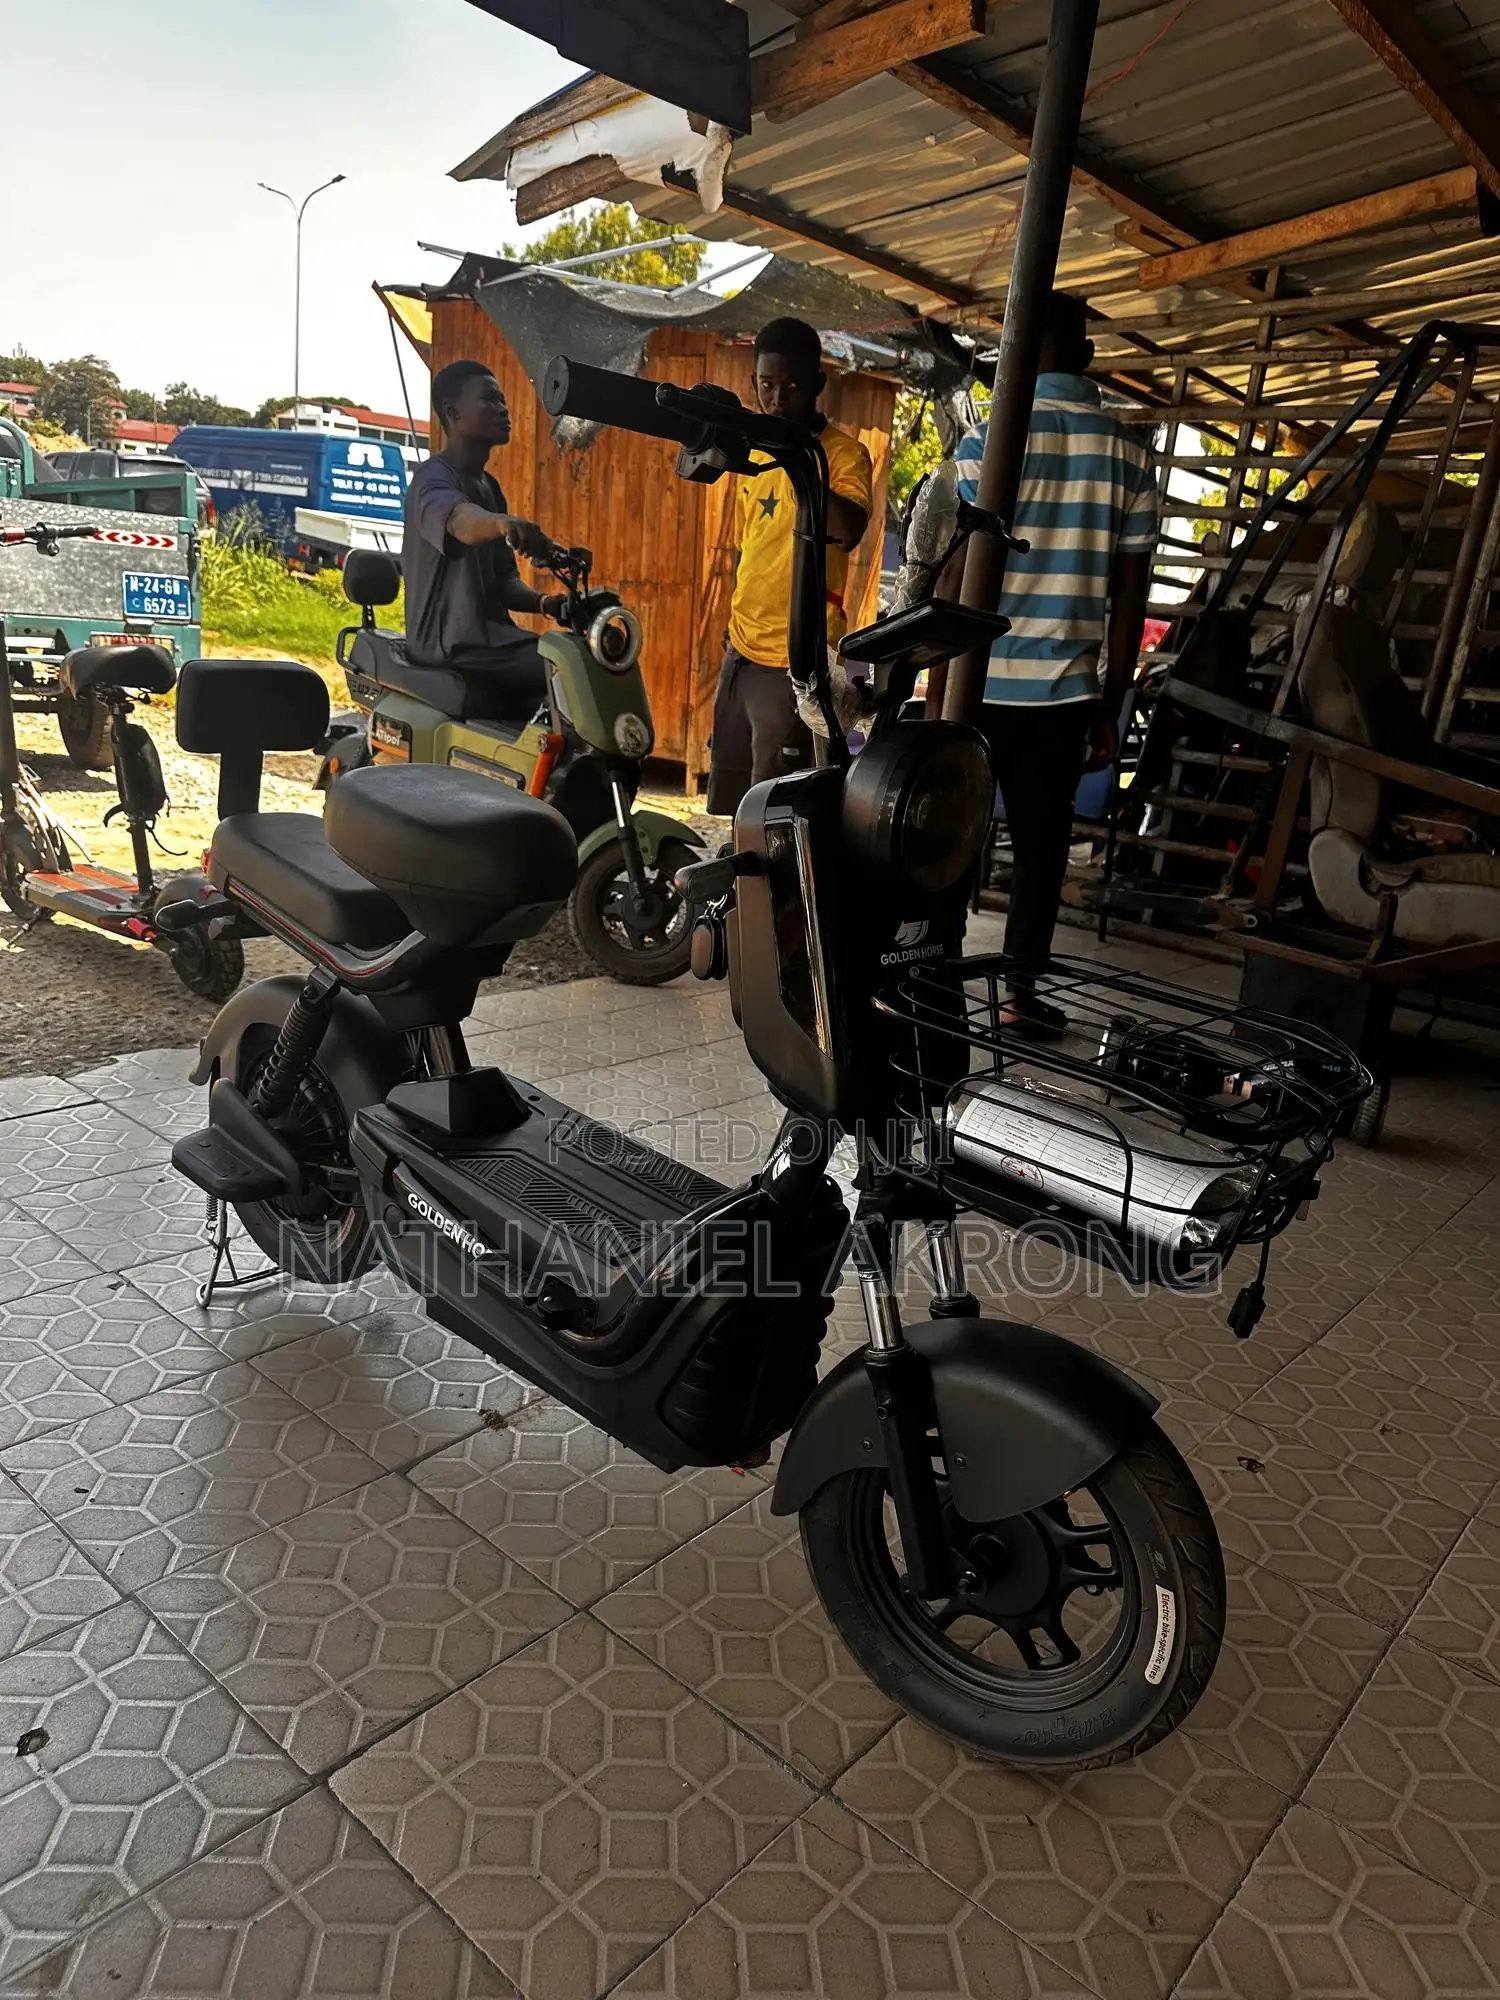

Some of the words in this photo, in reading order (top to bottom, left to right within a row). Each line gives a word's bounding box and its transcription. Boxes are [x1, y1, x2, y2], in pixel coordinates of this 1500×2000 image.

[144, 597, 176, 615] 6573
[881, 949, 921, 965] GOLDEN
[921, 944, 944, 959] HORSE
[774, 1135, 793, 1159] GOLDEN
[408, 1193, 465, 1244] GOLDEN
[1161, 1593, 1170, 1622] Electric
[1154, 1621, 1171, 1668] bike-specific
[1149, 1663, 1161, 1680] tires
